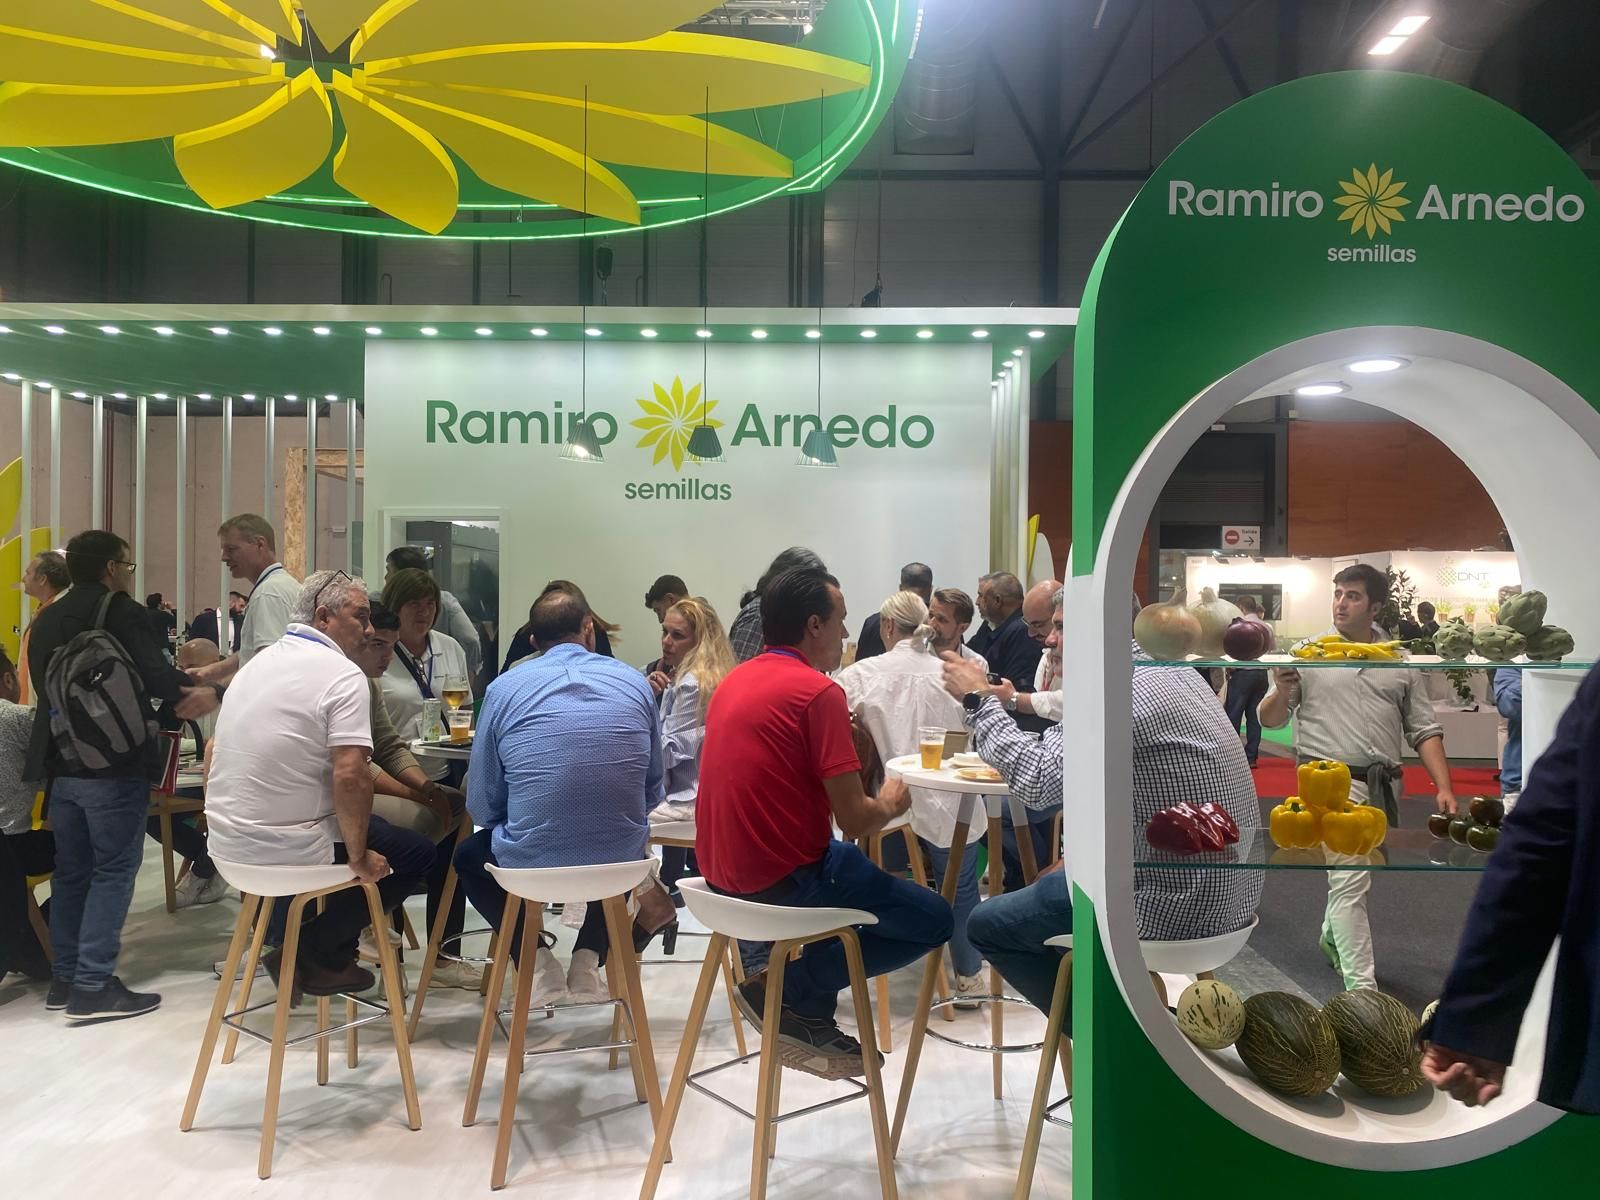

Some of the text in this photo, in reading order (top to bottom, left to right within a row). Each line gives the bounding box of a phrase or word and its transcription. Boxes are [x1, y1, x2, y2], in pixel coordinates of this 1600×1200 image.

[1168, 180, 1585, 222] Ramiro Arnedo
[1327, 244, 1417, 264] semillas
[426, 399, 619, 445] Ramiro
[624, 477, 732, 501] semillas
[1457, 571, 1489, 582] DNT
